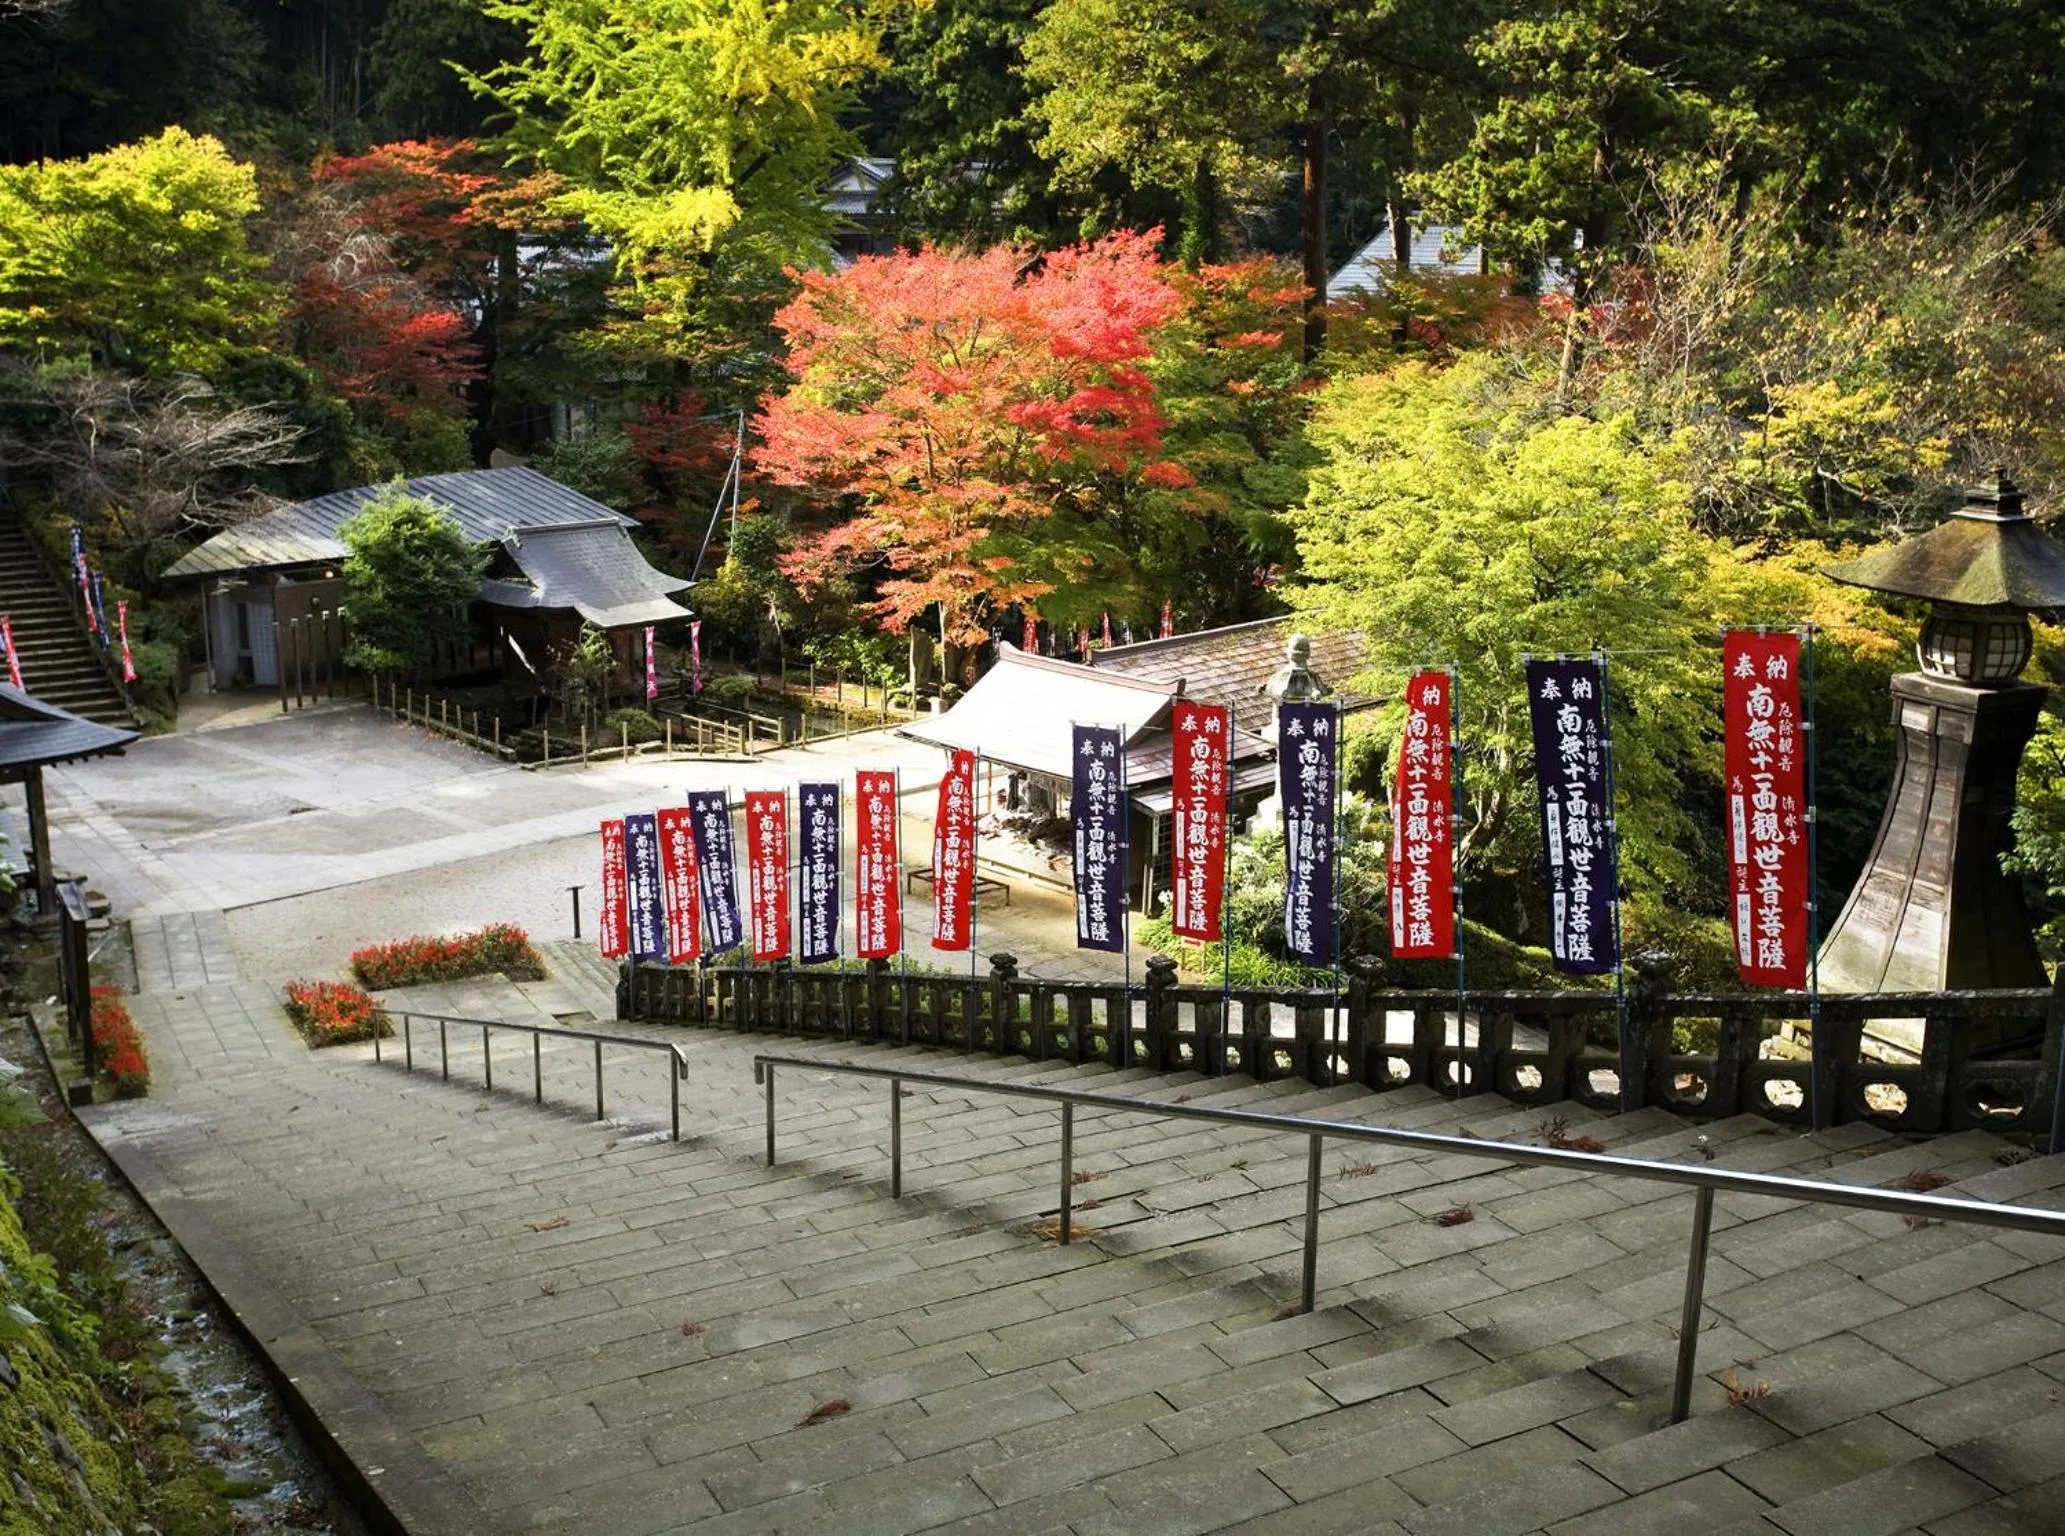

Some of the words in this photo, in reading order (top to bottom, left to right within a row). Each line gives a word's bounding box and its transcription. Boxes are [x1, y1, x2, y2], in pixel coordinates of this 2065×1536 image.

[1734, 653, 1787, 680] 奉納
[1541, 677, 1593, 700] 奉納
[1181, 714, 1220, 733] 奉納
[1287, 718, 1329, 737] 奉納
[1778, 702, 1794, 772] 厄除観音
[1080, 739, 1115, 757] 奉納
[1585, 718, 1599, 782] 厄除観音
[862, 780, 890, 794] 奉納
[696, 800, 723, 811] 奉納
[752, 801, 780, 813] 奉納
[805, 794, 833, 806] 奉納
[1782, 796, 1800, 845] 清水寺
